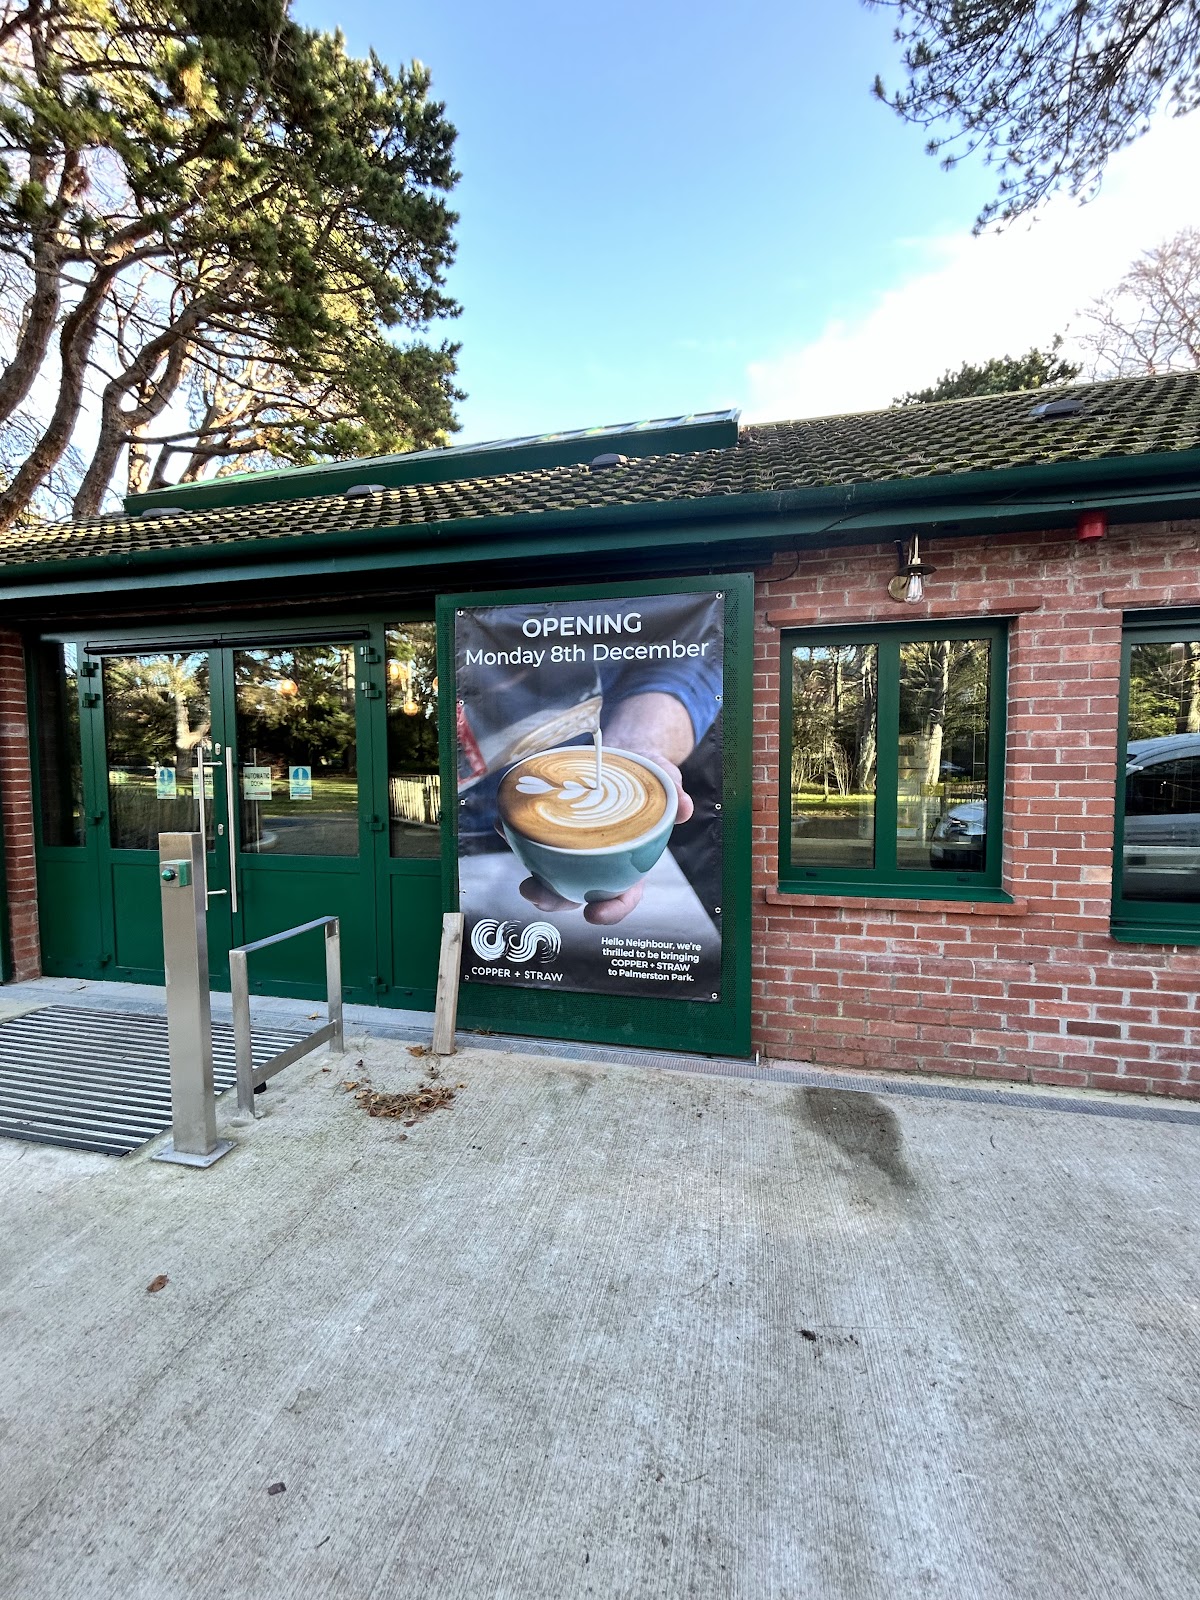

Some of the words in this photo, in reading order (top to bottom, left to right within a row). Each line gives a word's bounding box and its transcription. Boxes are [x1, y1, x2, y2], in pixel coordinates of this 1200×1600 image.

[522, 612, 642, 638] OPENING
[465, 647, 545, 668] Monday
[550, 644, 586, 663] 8th
[593, 639, 709, 661] December
[601, 936, 624, 946] Hello
[625, 938, 675, 950] Neighbour,
[676, 942, 702, 951] we're
[602, 948, 634, 958] thrilled
[636, 950, 646, 958] to
[647, 950, 659, 959] be
[660, 951, 700, 963] bringing
[611, 959, 648, 968] COPPER
[656, 961, 690, 971] STRAW
[471, 966, 511, 978] COPPER
[524, 970, 563, 982] STRAW
[608, 968, 617, 976] to
[618, 969, 669, 980] Palmerston
[671, 973, 694, 982] Park.
